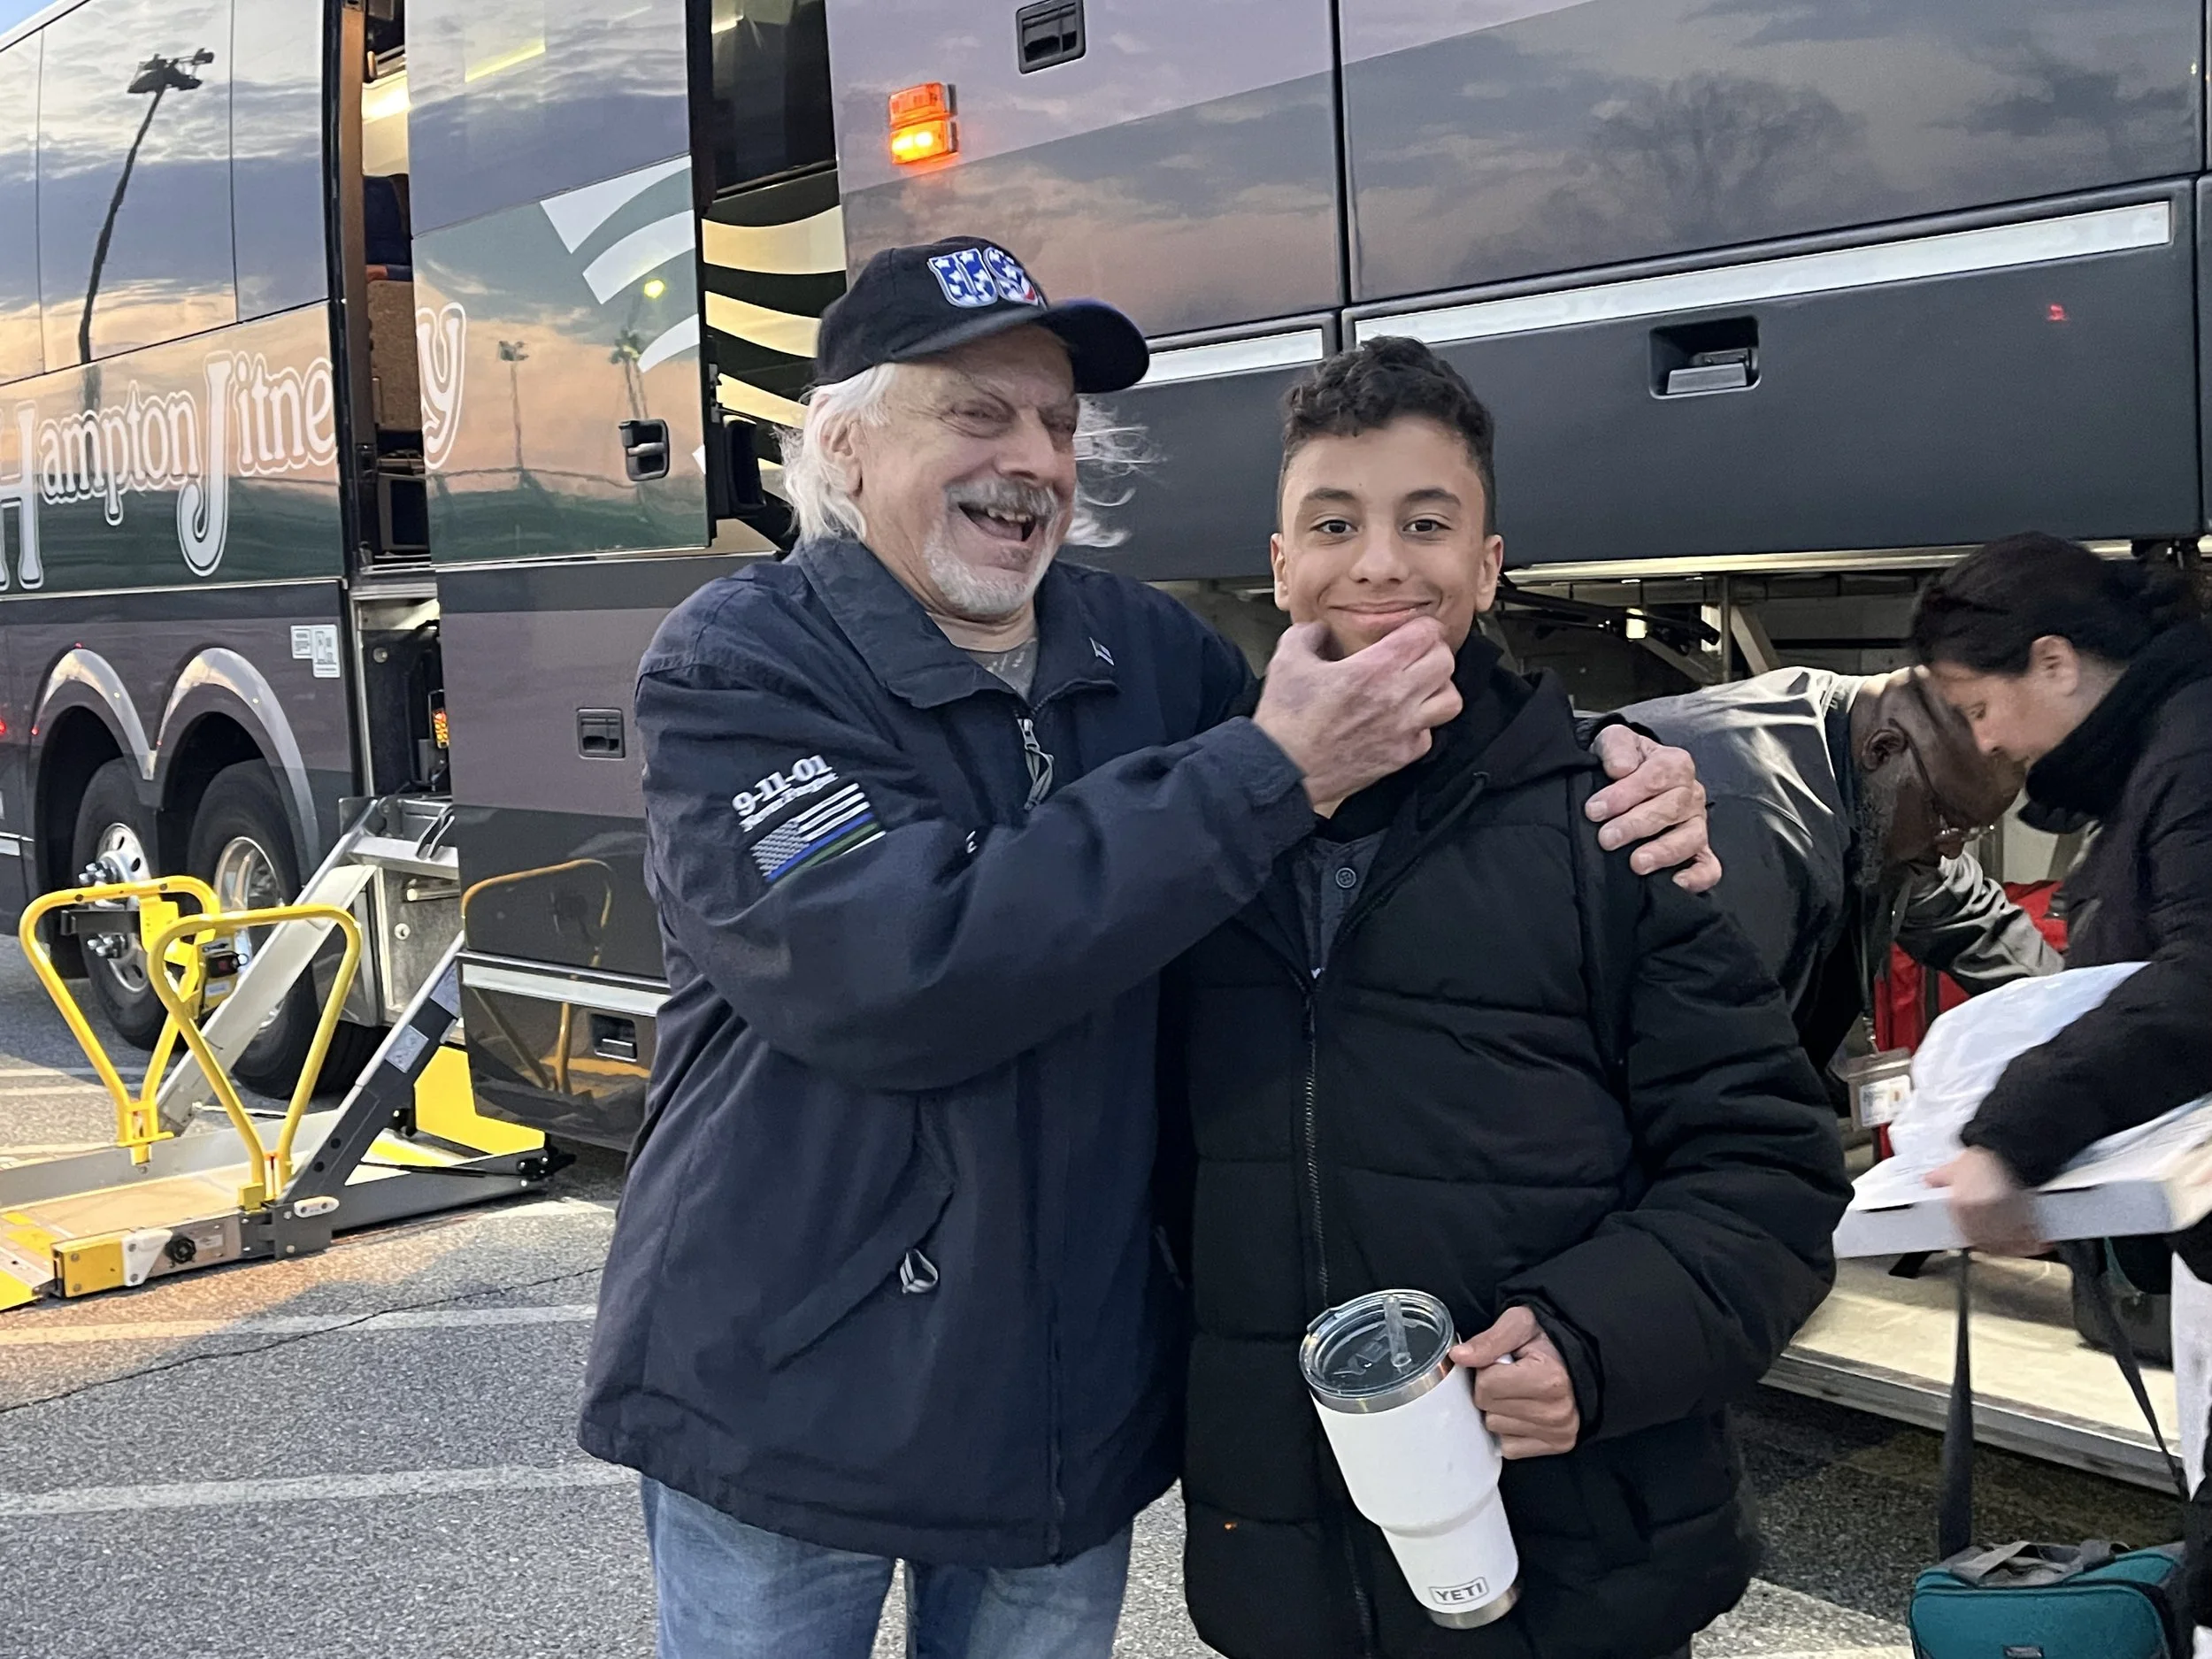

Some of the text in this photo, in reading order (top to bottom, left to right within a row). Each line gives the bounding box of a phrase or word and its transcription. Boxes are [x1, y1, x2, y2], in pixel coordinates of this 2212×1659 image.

[927, 247, 1047, 310] US
[0, 302, 466, 590] Hampton Jitney
[732, 755, 833, 817] 9-11-01
[1434, 1582, 1484, 1601] YETI
